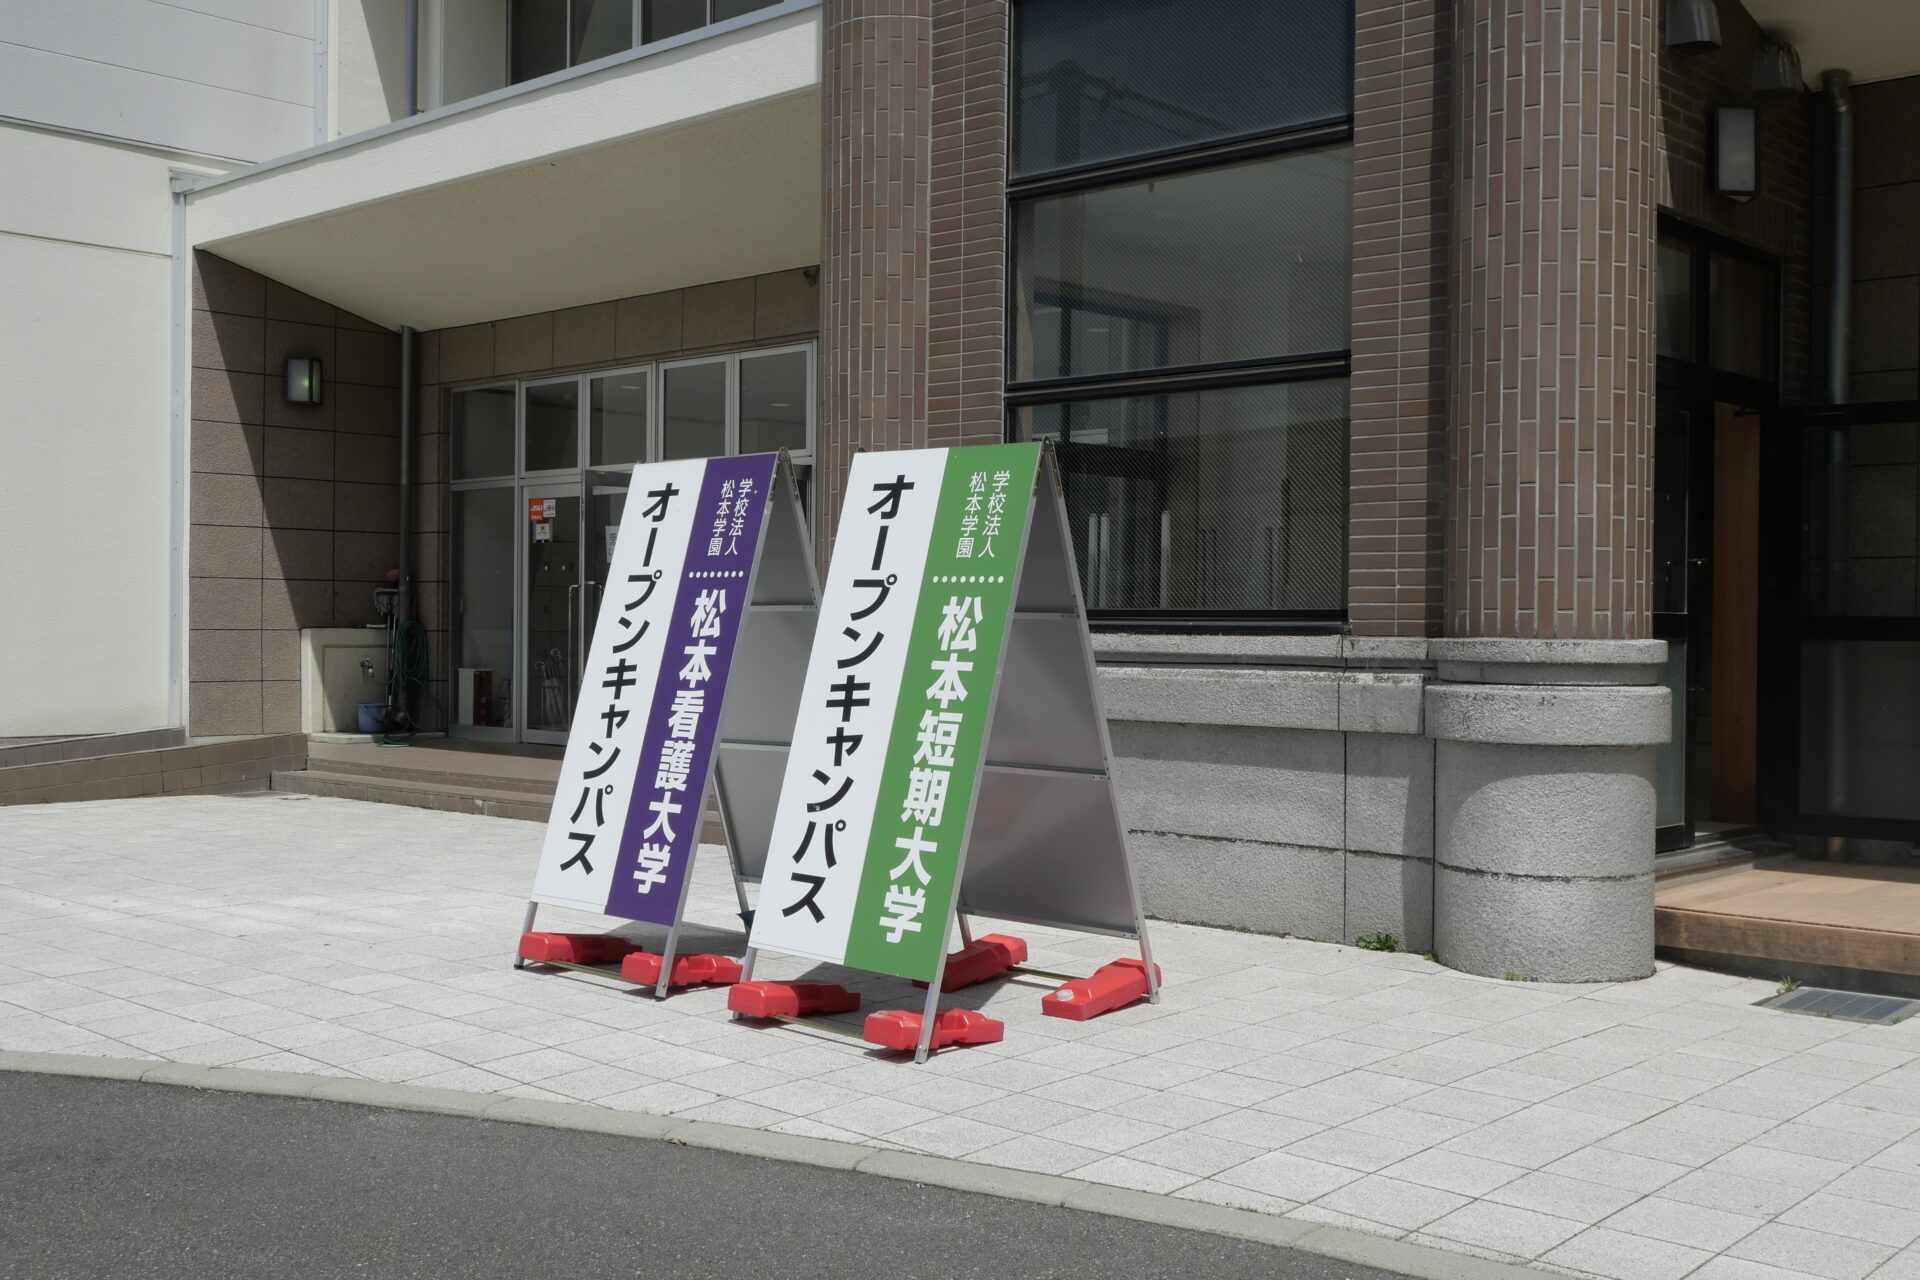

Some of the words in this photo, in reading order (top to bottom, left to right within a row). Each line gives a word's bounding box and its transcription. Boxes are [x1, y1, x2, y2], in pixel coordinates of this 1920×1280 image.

[708, 480, 735, 556] 松本学園
[725, 478, 753, 555] 学校法人
[956, 472, 986, 558] 松本学園
[978, 471, 1010, 557] 学校法人
[560, 483, 679, 874] オープンキャンパス
[633, 589, 726, 894] 松本看護大学
[782, 475, 914, 923] オープンキャンパス
[879, 596, 983, 943] 松本短期大学
